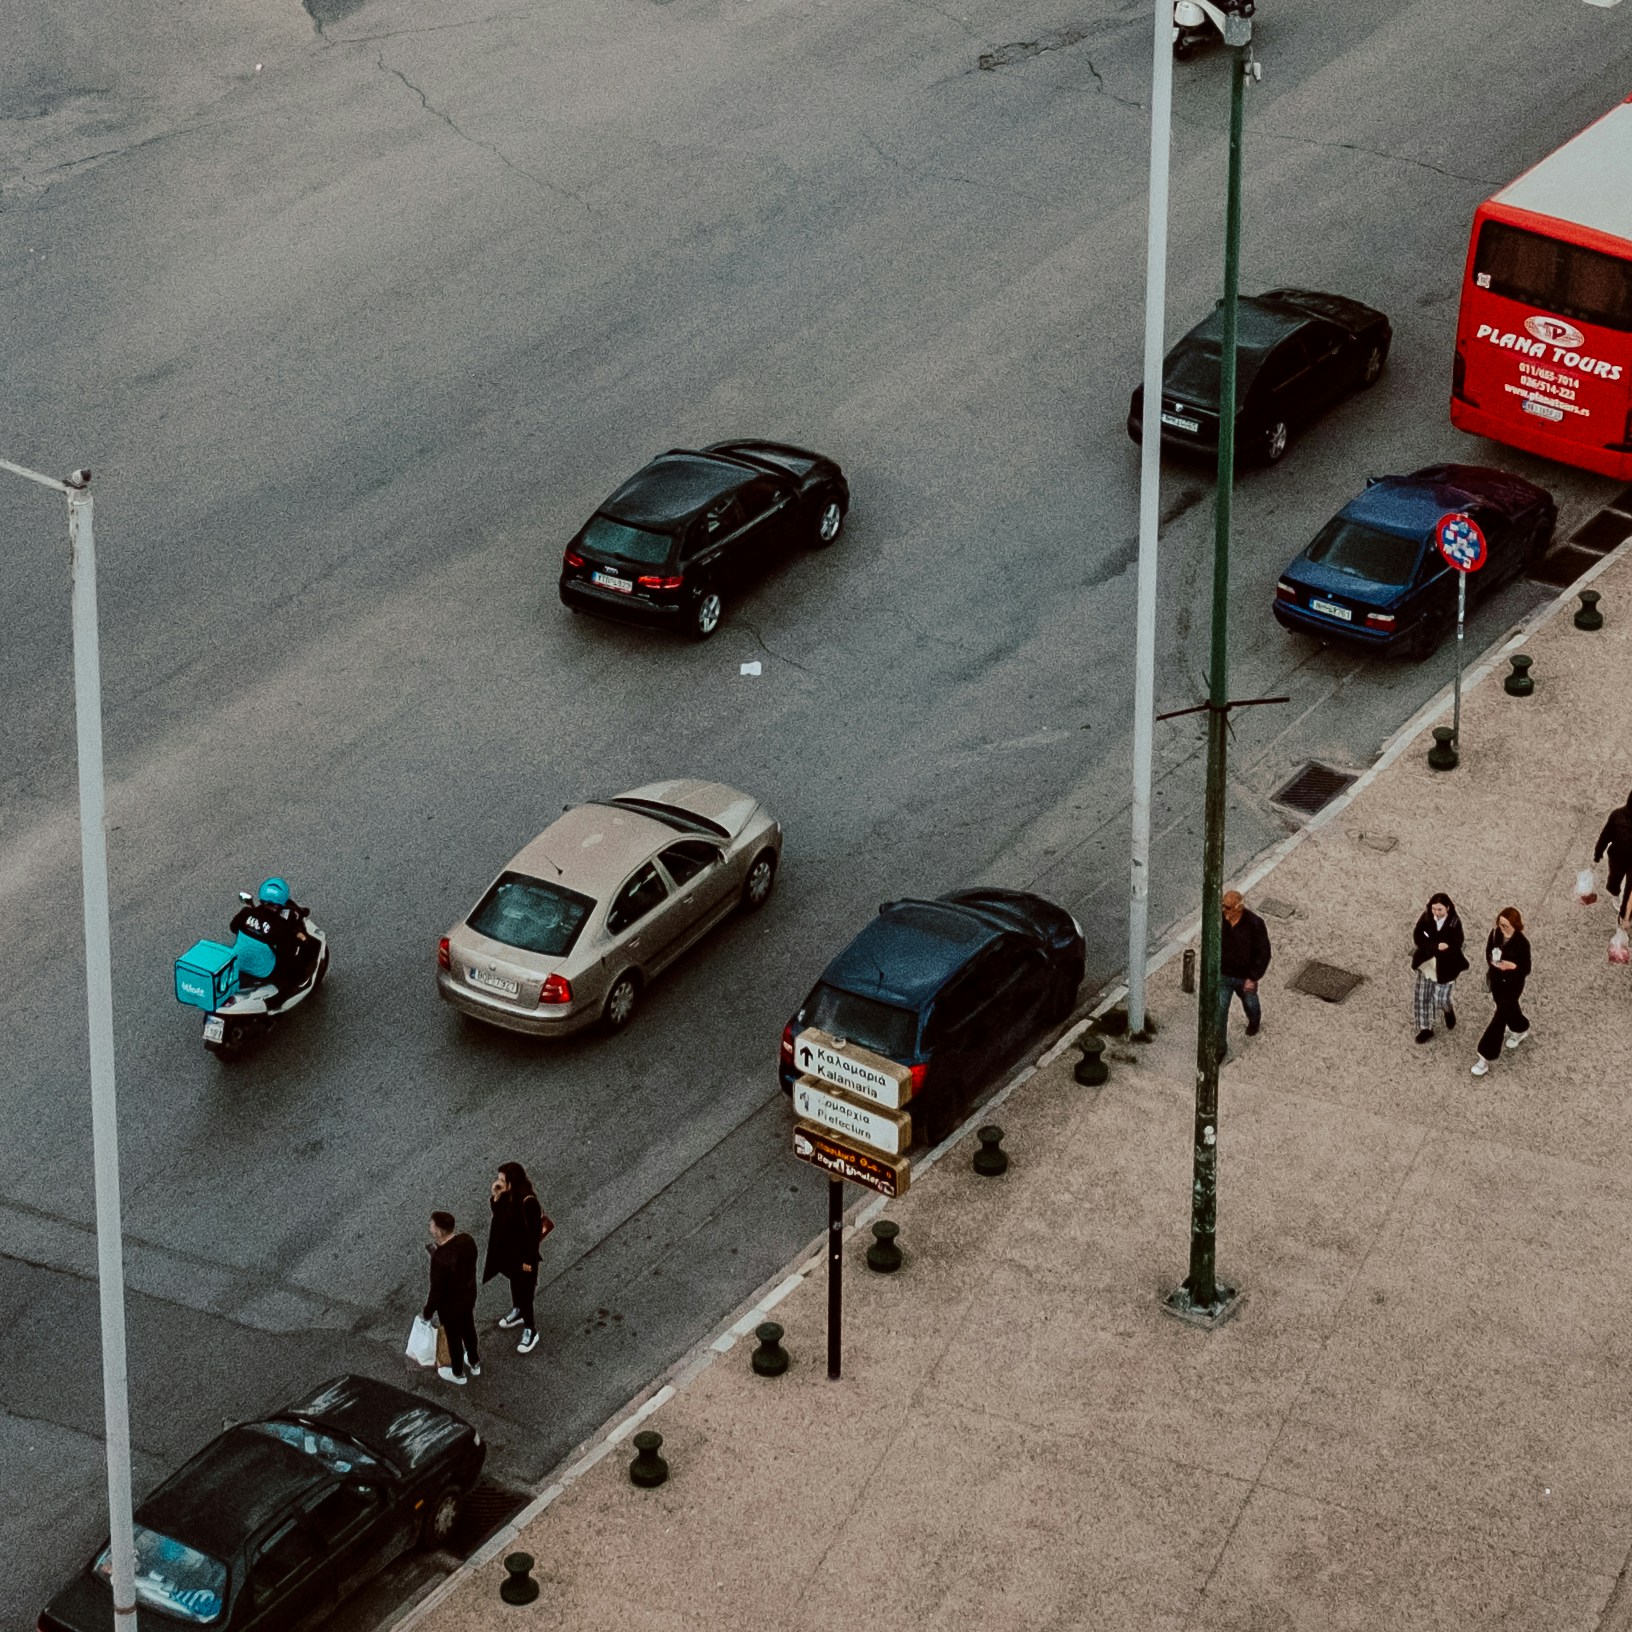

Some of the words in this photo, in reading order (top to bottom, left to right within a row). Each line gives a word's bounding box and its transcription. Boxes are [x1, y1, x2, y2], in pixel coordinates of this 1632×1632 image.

[1476, 324, 1547, 358] PLANA
[1552, 347, 1623, 381] TOURS
[817, 1048, 887, 1087] Καλαμαριά
[817, 1064, 878, 1099] Kalamaria
[818, 1096, 871, 1125] ομαρχία
